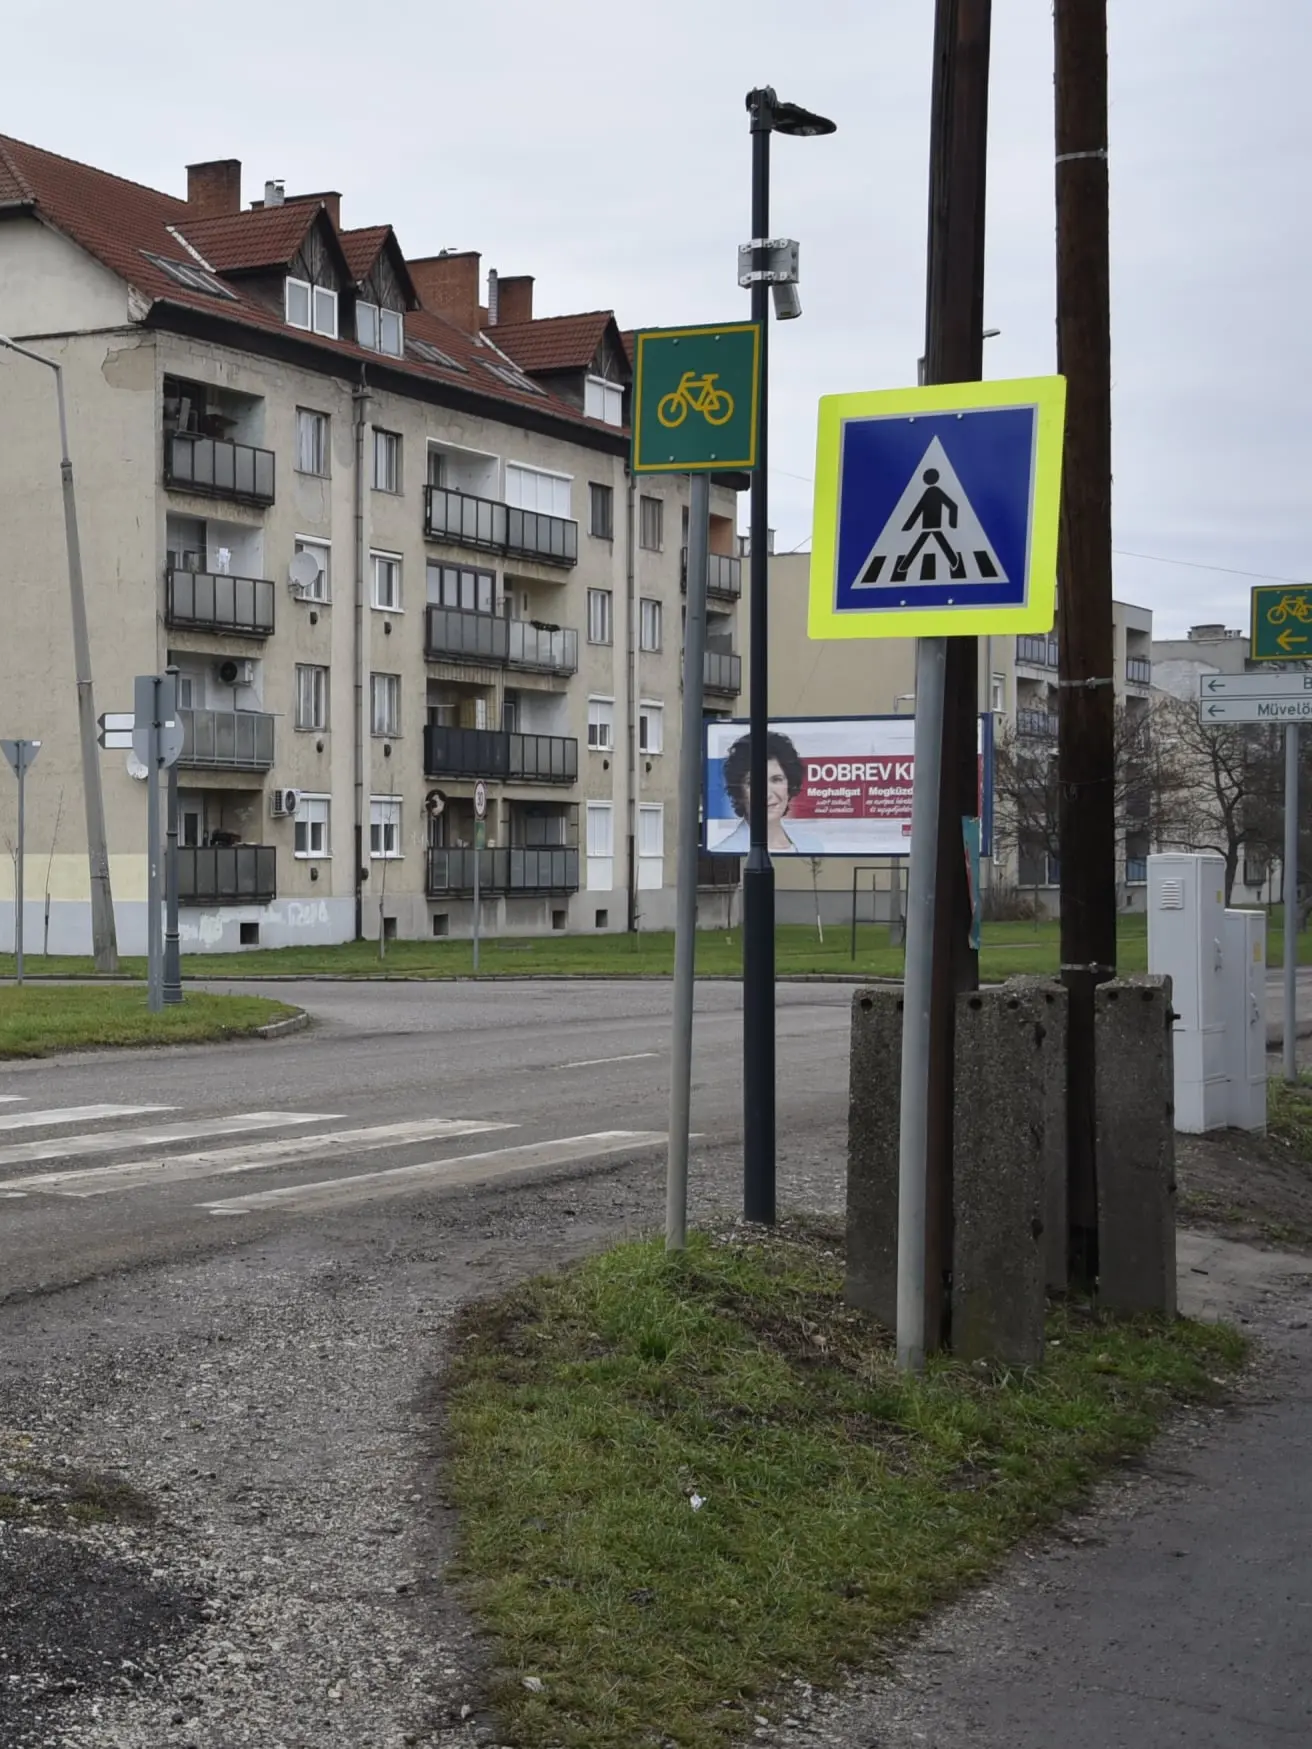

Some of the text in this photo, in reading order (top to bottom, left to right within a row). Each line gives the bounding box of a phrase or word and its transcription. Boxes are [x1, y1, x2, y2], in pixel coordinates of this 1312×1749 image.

[1257, 702, 1312, 717] Művelő
[807, 763, 893, 781] DOBREV
[807, 787, 862, 798] Meghallgat
